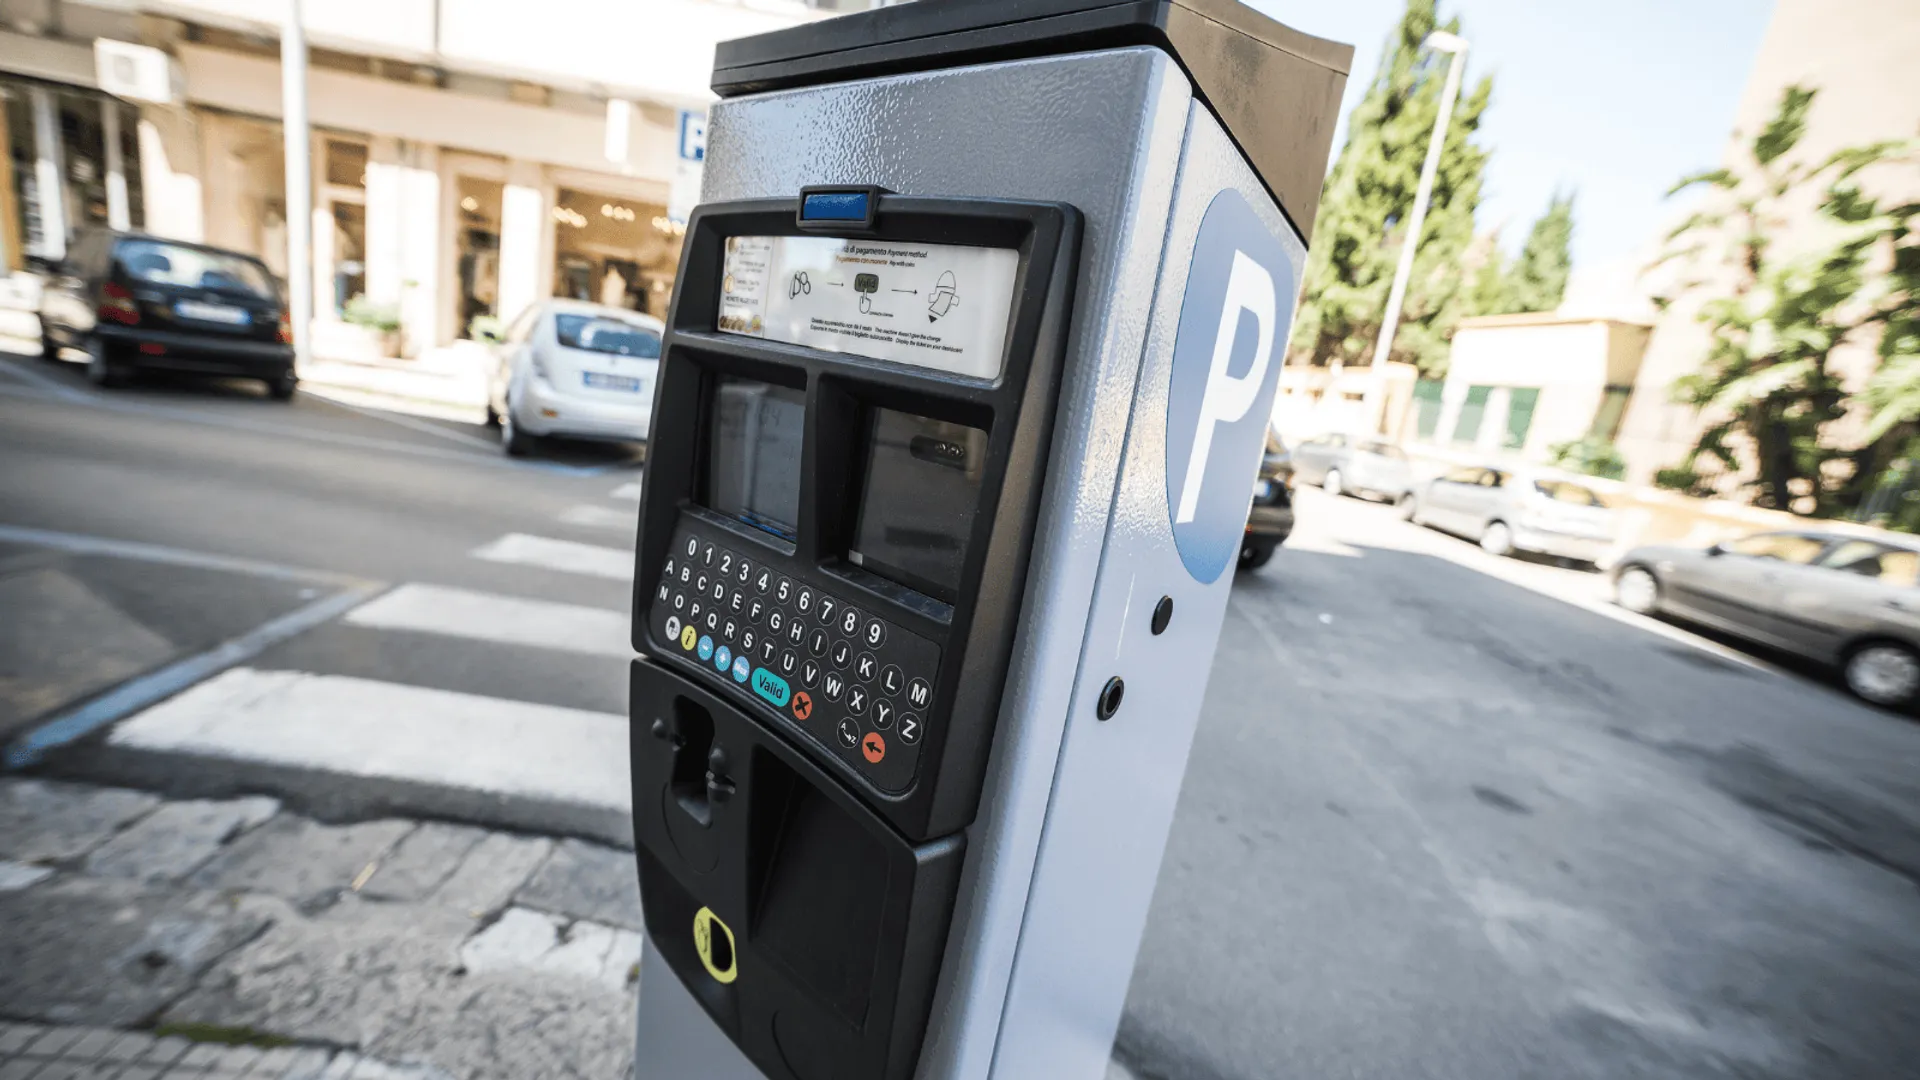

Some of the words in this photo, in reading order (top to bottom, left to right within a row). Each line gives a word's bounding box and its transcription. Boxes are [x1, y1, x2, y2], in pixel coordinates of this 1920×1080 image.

[856, 246, 887, 256] pagamento
[887, 248, 908, 258] Payment
[908, 250, 928, 258] method
[1176, 249, 1276, 524] P
[665, 560, 674, 575] A
[681, 567, 690, 582] B
[698, 576, 707, 591] C
[714, 584, 724, 599] D
[732, 593, 742, 610] E
[751, 603, 761, 618] F
[771, 614, 781, 629] G
[791, 623, 803, 641] H
[816, 635, 822, 650] I
[836, 648, 847, 663] J
[860, 658, 873, 677] K
[887, 671, 897, 690] L
[911, 683, 928, 705] M
[688, 540, 697, 556] 0
[706, 548, 713, 564] 1
[721, 556, 731, 573] 2
[740, 564, 749, 581] 3
[758, 574, 769, 591] 4
[779, 581, 790, 599] 5
[800, 592, 810, 610] 6
[822, 601, 834, 619] 7
[845, 613, 856, 632] 8
[869, 624, 881, 644] 9
[660, 586, 669, 601] N
[675, 595, 684, 609] O
[691, 603, 700, 617] P
[707, 613, 717, 630] Q
[724, 622, 735, 639] R
[743, 633, 753, 648] S
[765, 643, 774, 659] T
[783, 654, 795, 671] U
[806, 665, 817, 683] V
[826, 676, 842, 697] W
[850, 690, 864, 710] X
[879, 704, 890, 723] Y
[902, 719, 917, 740] Z
[685, 630, 693, 646] i
[759, 674, 784, 699] Valid
[840, 722, 847, 731] A
